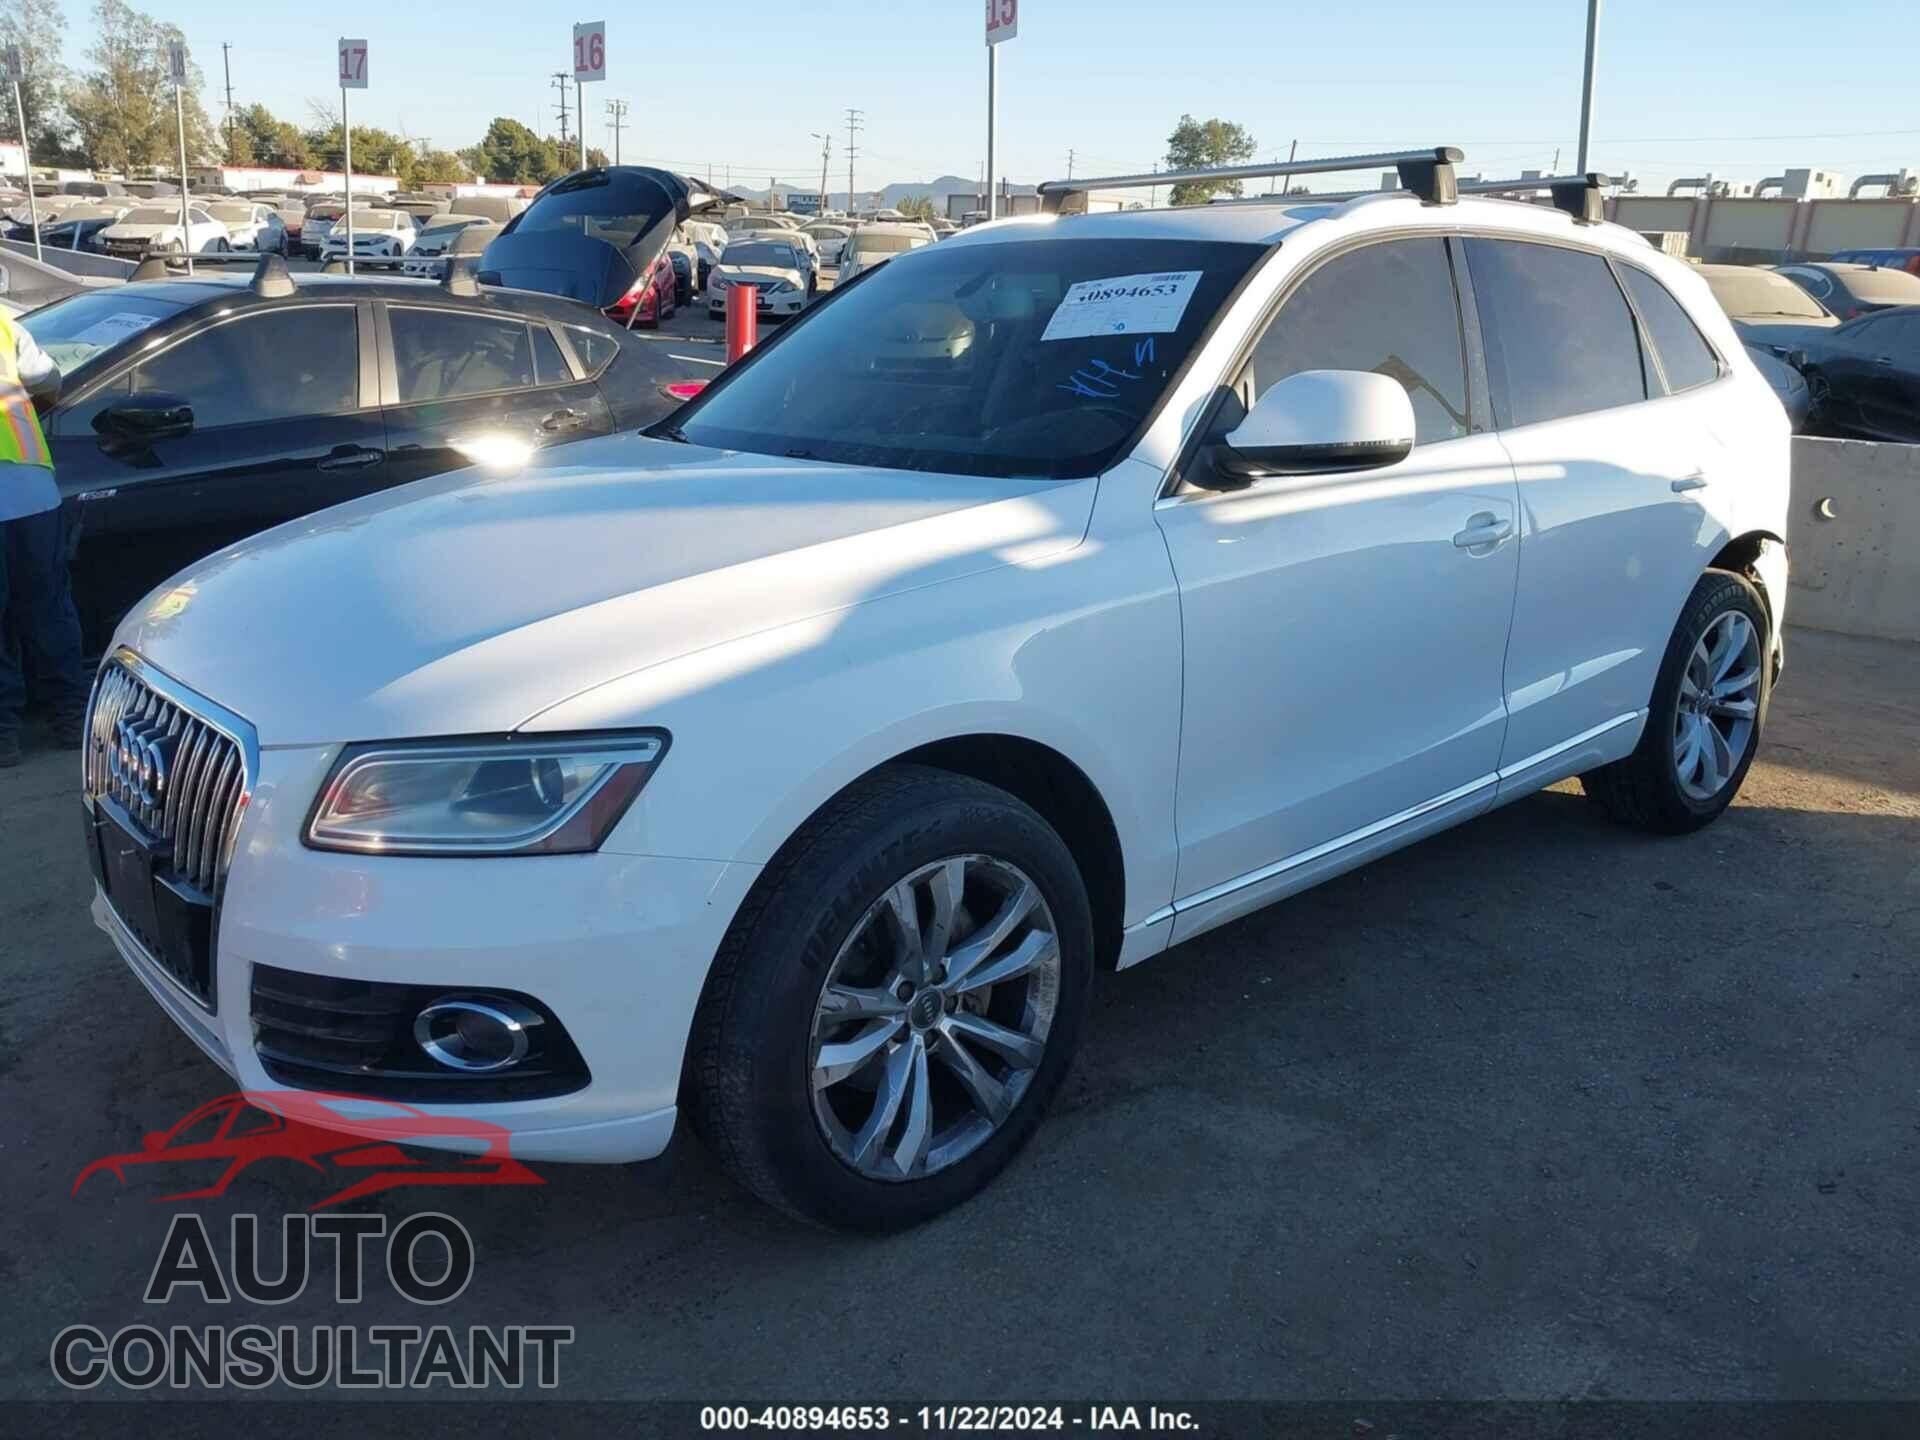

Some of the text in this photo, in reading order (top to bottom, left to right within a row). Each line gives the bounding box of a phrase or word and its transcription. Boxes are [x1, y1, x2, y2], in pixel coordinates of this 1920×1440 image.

[986, 0, 1016, 32] 15
[339, 48, 367, 80] 17
[574, 33, 604, 73] 16
